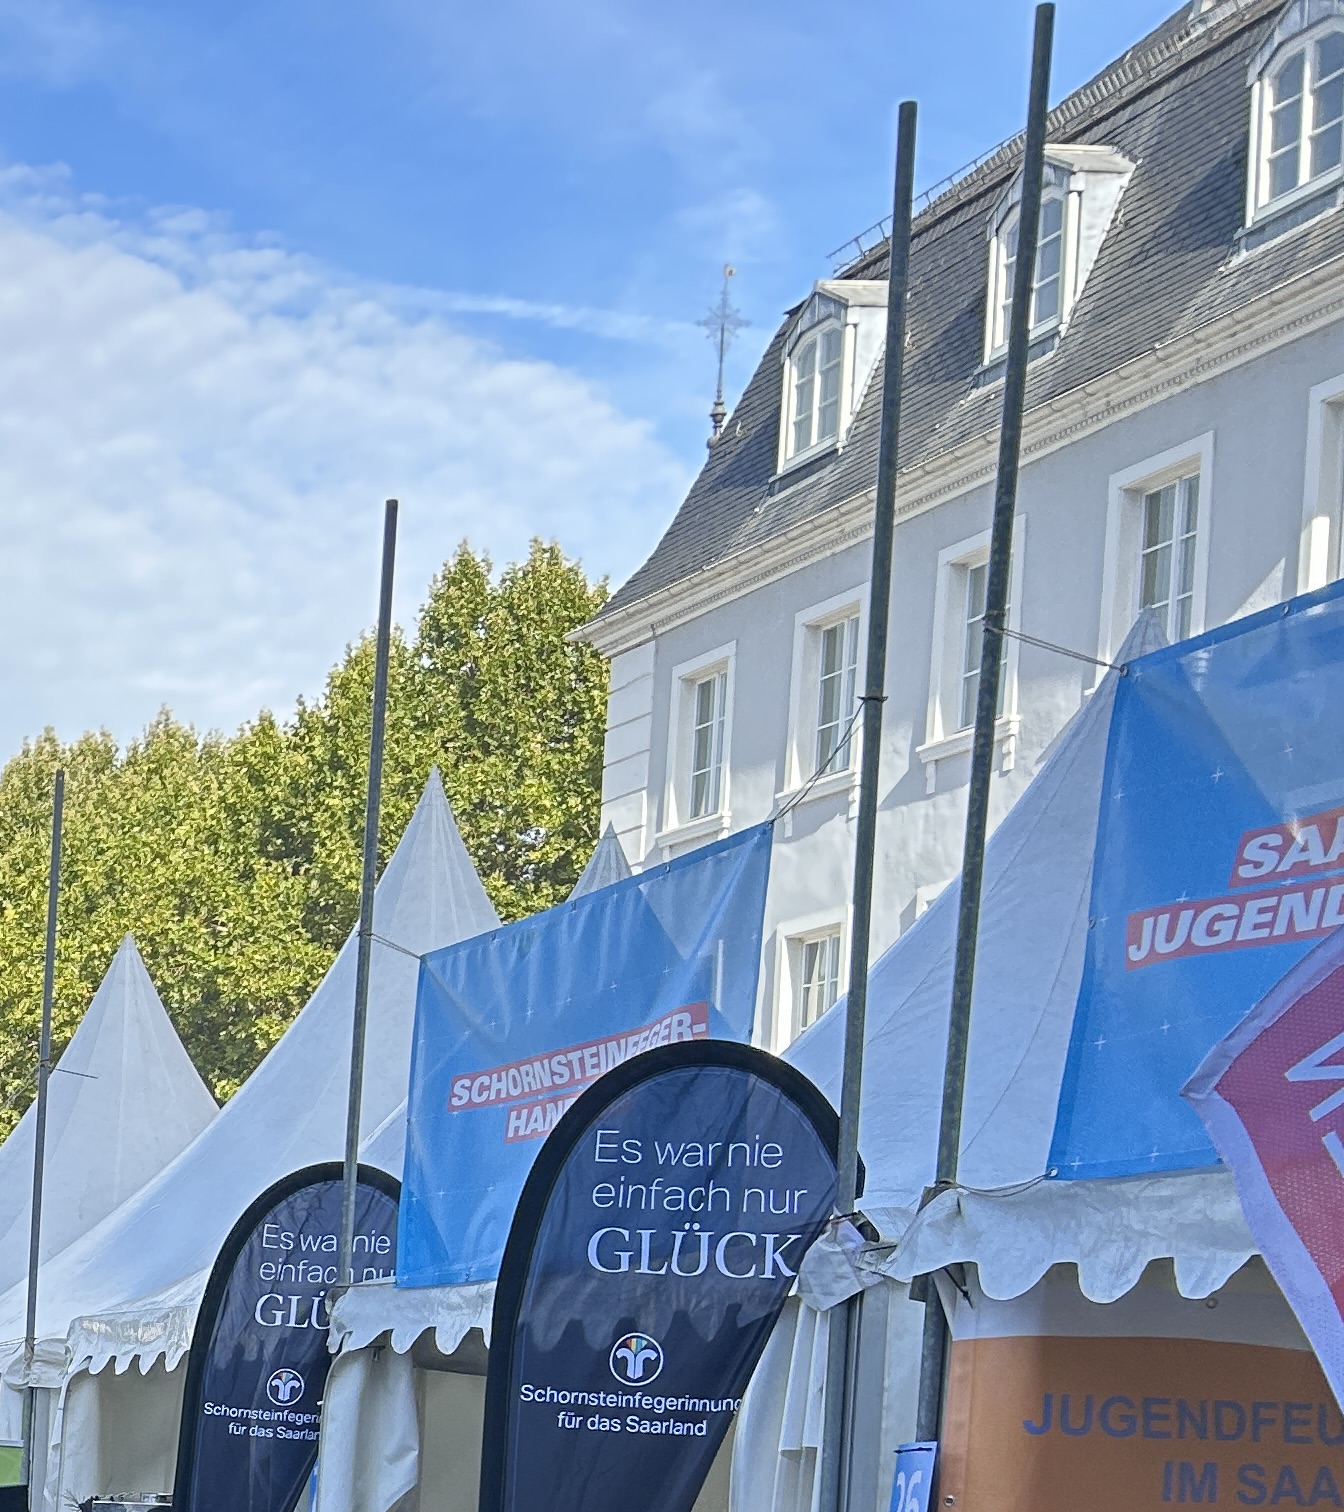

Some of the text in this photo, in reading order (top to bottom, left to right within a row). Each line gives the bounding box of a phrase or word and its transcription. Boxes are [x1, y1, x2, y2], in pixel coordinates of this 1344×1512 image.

[450, 1012, 707, 1107] SCHORNSTEINFEGER-
[506, 1099, 578, 1138] HAN
[594, 1129, 784, 1168] Es war nie
[592, 1175, 808, 1214] einfach nur
[261, 1223, 391, 1255] Es wa nie
[587, 1222, 803, 1279] GLÜCK
[259, 1257, 354, 1286] einfac
[520, 1383, 743, 1415] Schornsteinfegerinnung
[228, 1421, 247, 1435] für
[249, 1425, 274, 1438] das
[557, 1412, 708, 1437] für das Saarland
[1163, 1460, 1218, 1504] IM
